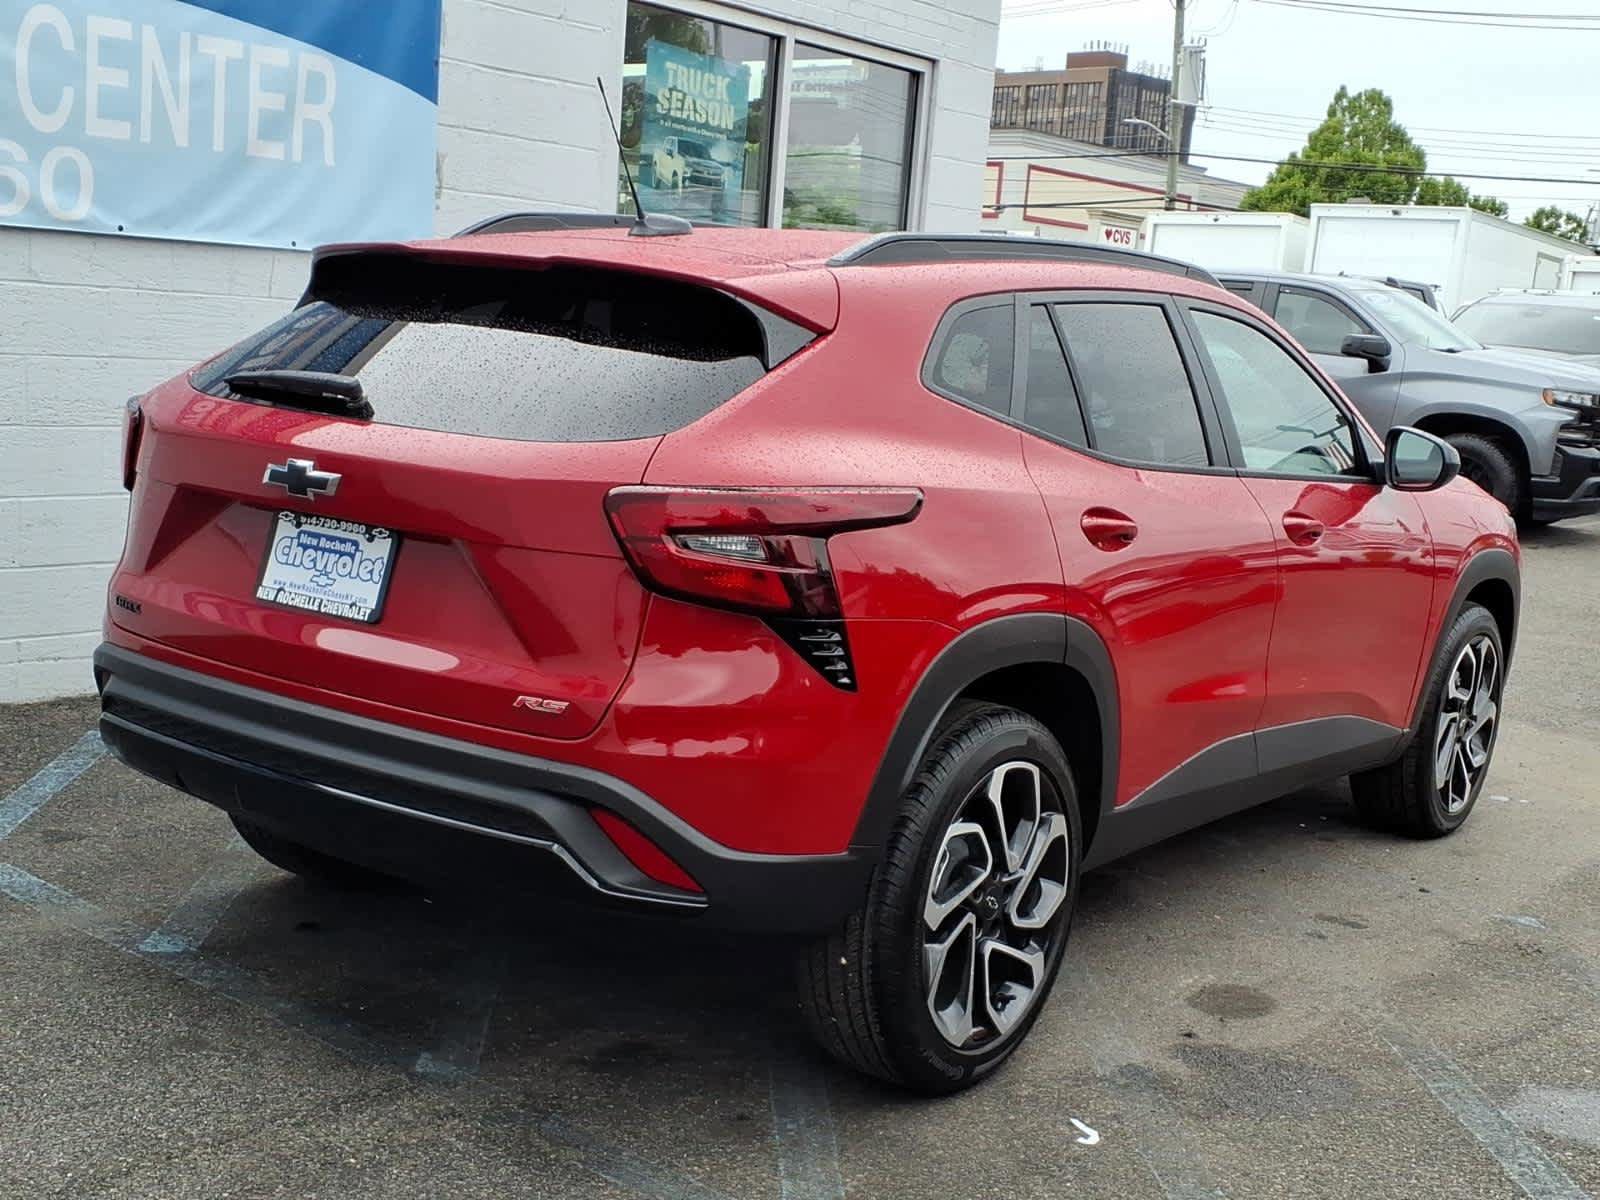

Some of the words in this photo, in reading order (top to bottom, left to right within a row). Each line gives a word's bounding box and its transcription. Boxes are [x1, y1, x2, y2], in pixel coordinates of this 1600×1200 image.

[15, 3, 337, 167] CENTER
[664, 60, 731, 102] TRUCK
[656, 87, 735, 131] SEASON
[1113, 229, 1131, 245] CVS
[300, 515, 366, 534] 914-730-9960
[275, 535, 385, 584] Chevrolet
[300, 533, 319, 547] New
[319, 536, 356, 554] Rochelle
[256, 585, 275, 601] NEW
[276, 588, 320, 611] ROCHELLE
[321, 598, 373, 622] CHEVROLET
[512, 695, 570, 714] RS
